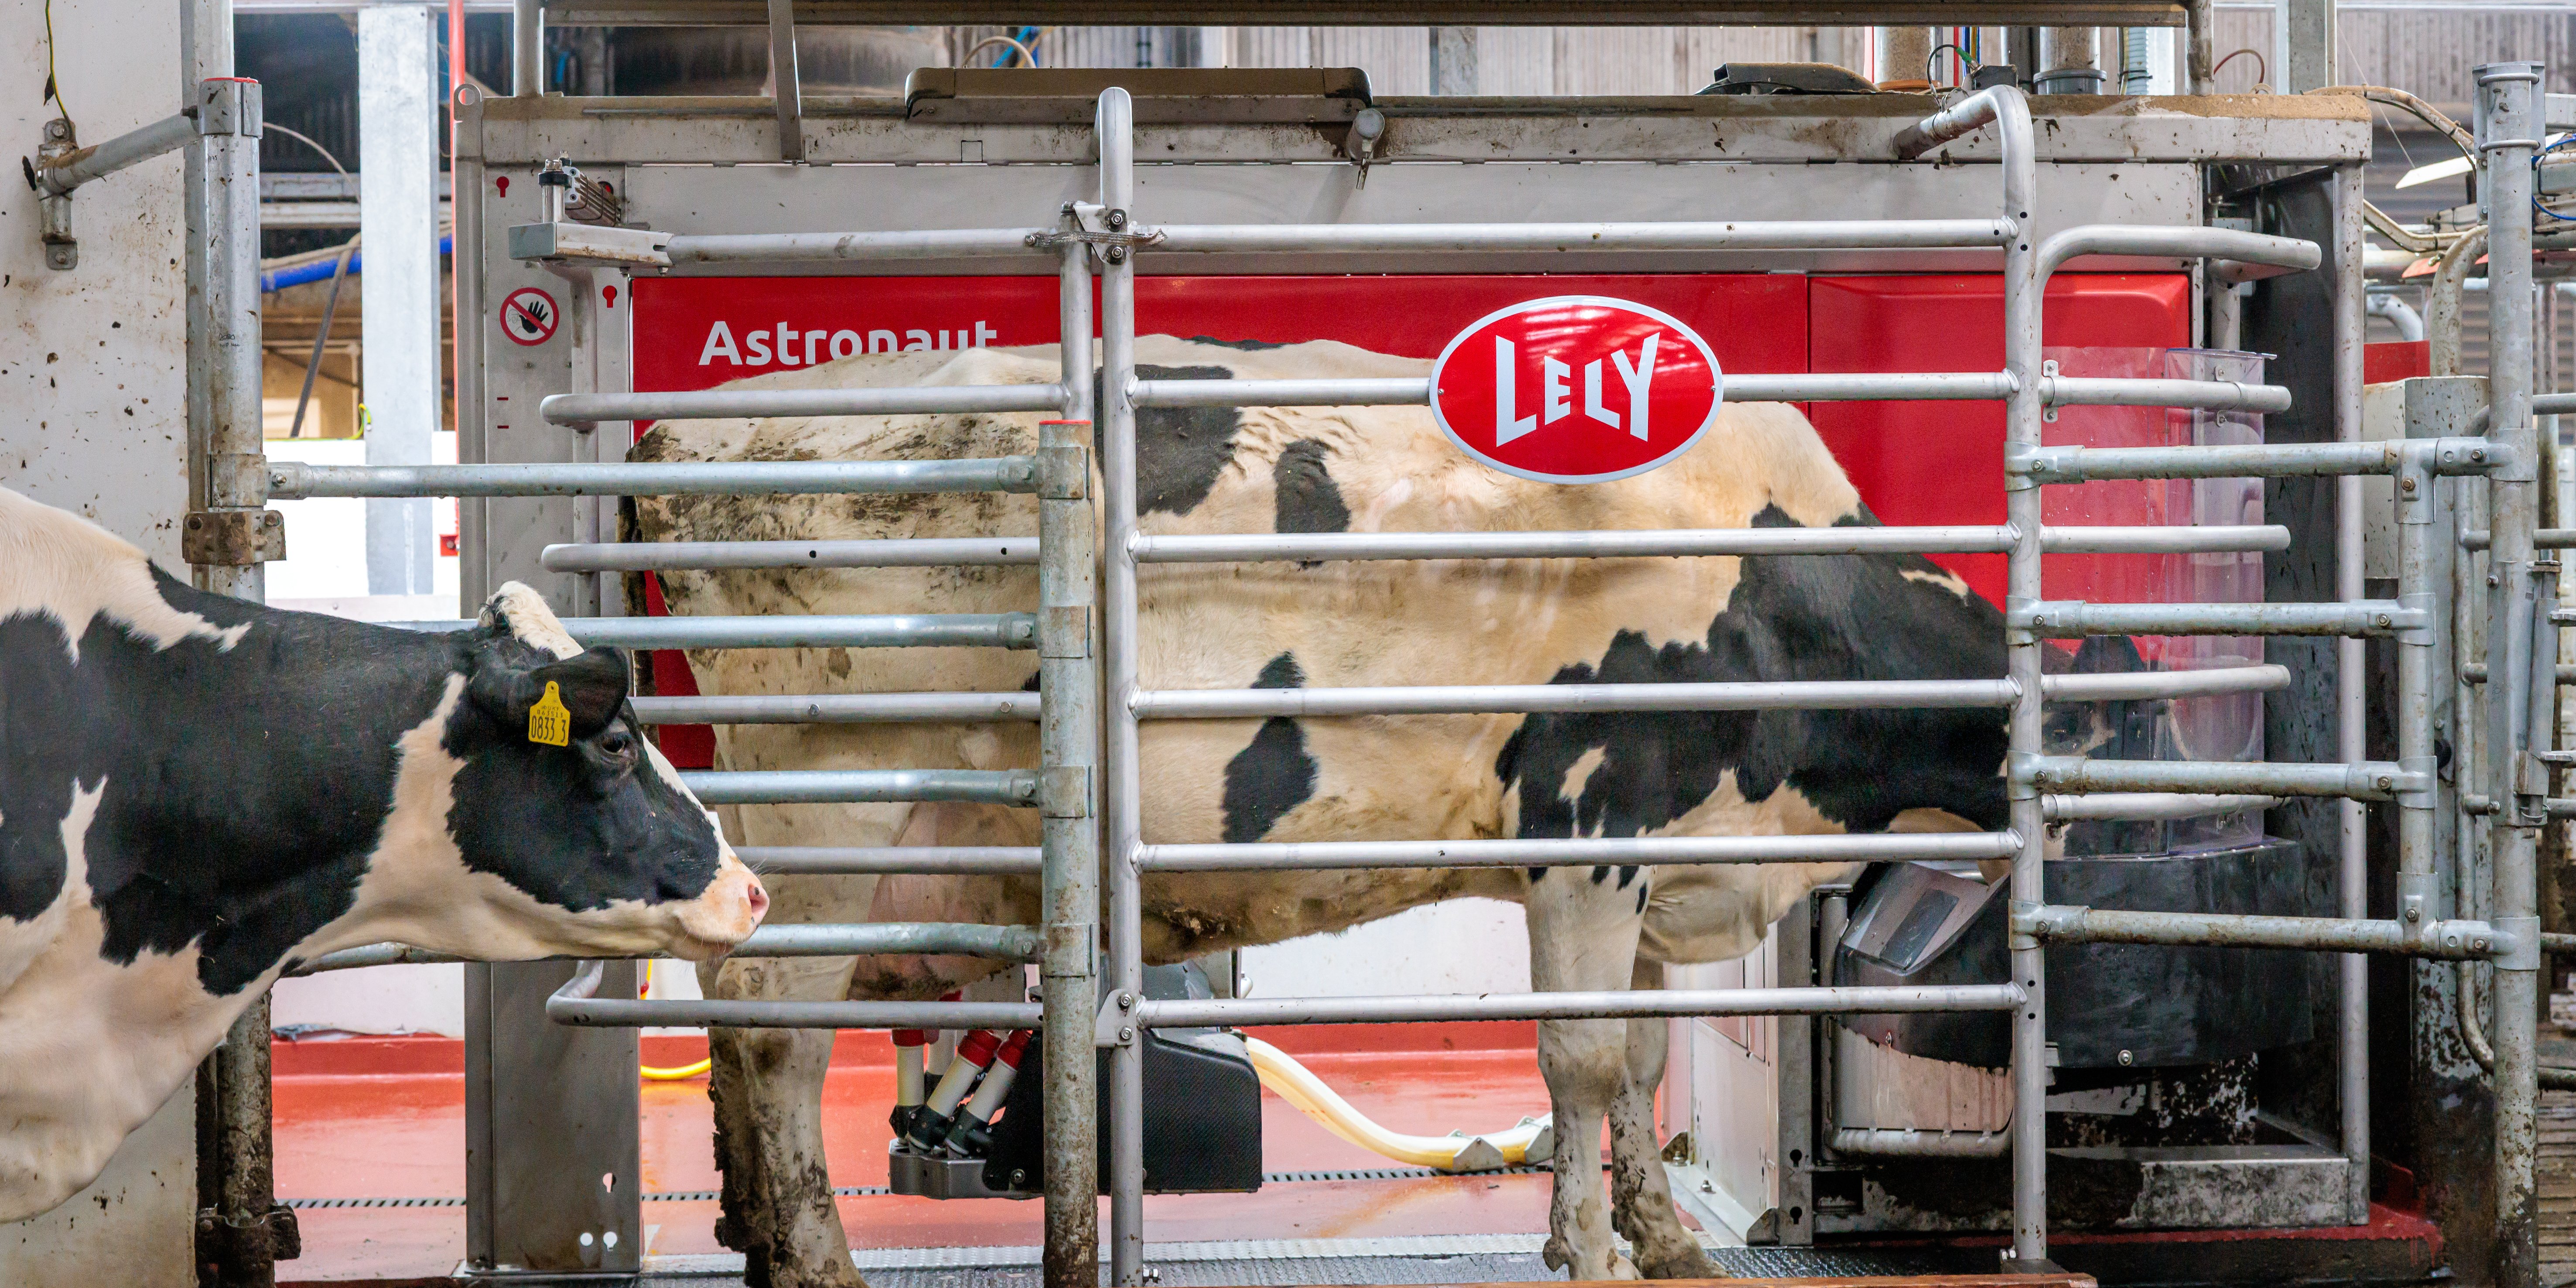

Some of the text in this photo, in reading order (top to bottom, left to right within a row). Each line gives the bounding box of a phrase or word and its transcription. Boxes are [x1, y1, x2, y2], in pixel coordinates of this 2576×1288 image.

[698, 321, 997, 366] Astronaut
[1496, 332, 1660, 447] LELY
[531, 715, 566, 743] 0833 3
